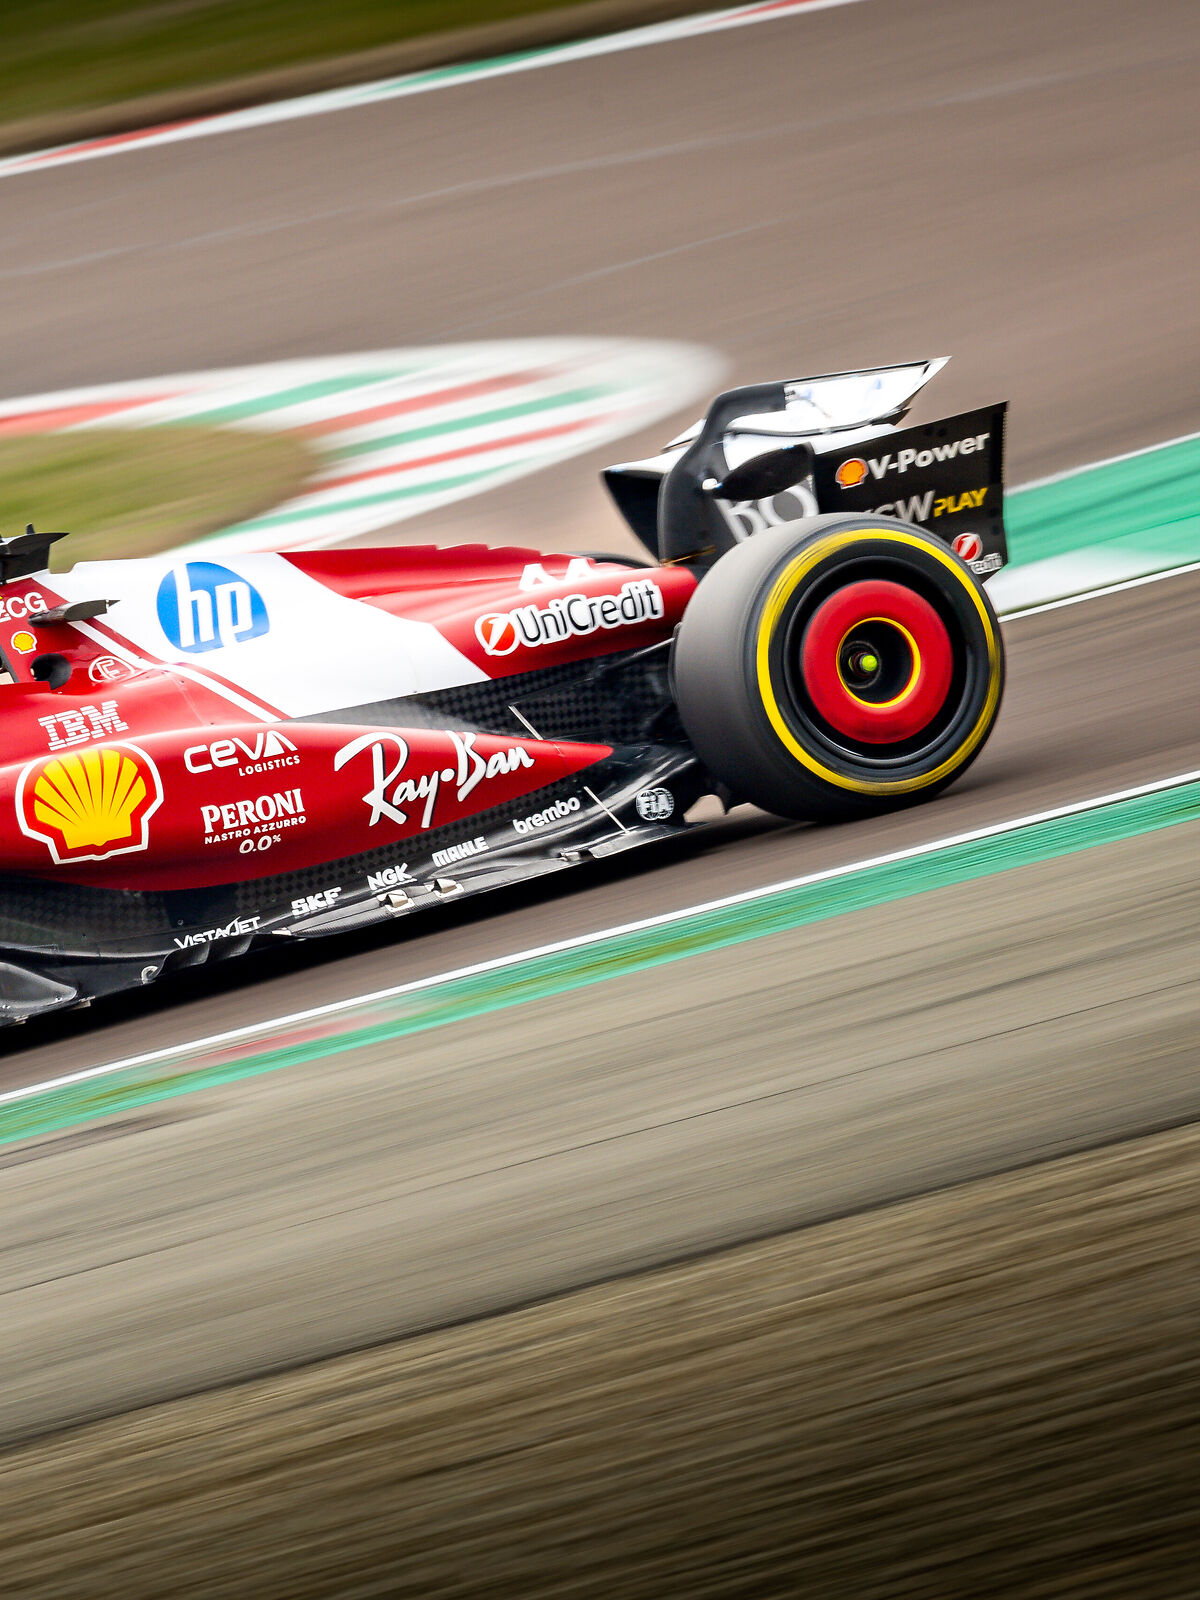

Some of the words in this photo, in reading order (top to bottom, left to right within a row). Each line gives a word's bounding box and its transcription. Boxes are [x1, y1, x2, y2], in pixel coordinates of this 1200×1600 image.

[867, 432, 990, 480] V-Power
[933, 487, 988, 518] PLAY
[173, 562, 254, 653] hp
[514, 580, 664, 647] UniCredit
[38, 700, 129, 751] IBM
[238, 754, 300, 777] LOGISTICS
[200, 788, 306, 834] PERONI
[513, 796, 581, 834] brembo
[204, 828, 251, 845] NASTRO
[253, 815, 307, 835] AZZURRO
[431, 836, 490, 868] MAHLE
[366, 863, 413, 891] NGK
[290, 886, 342, 918] SKF
